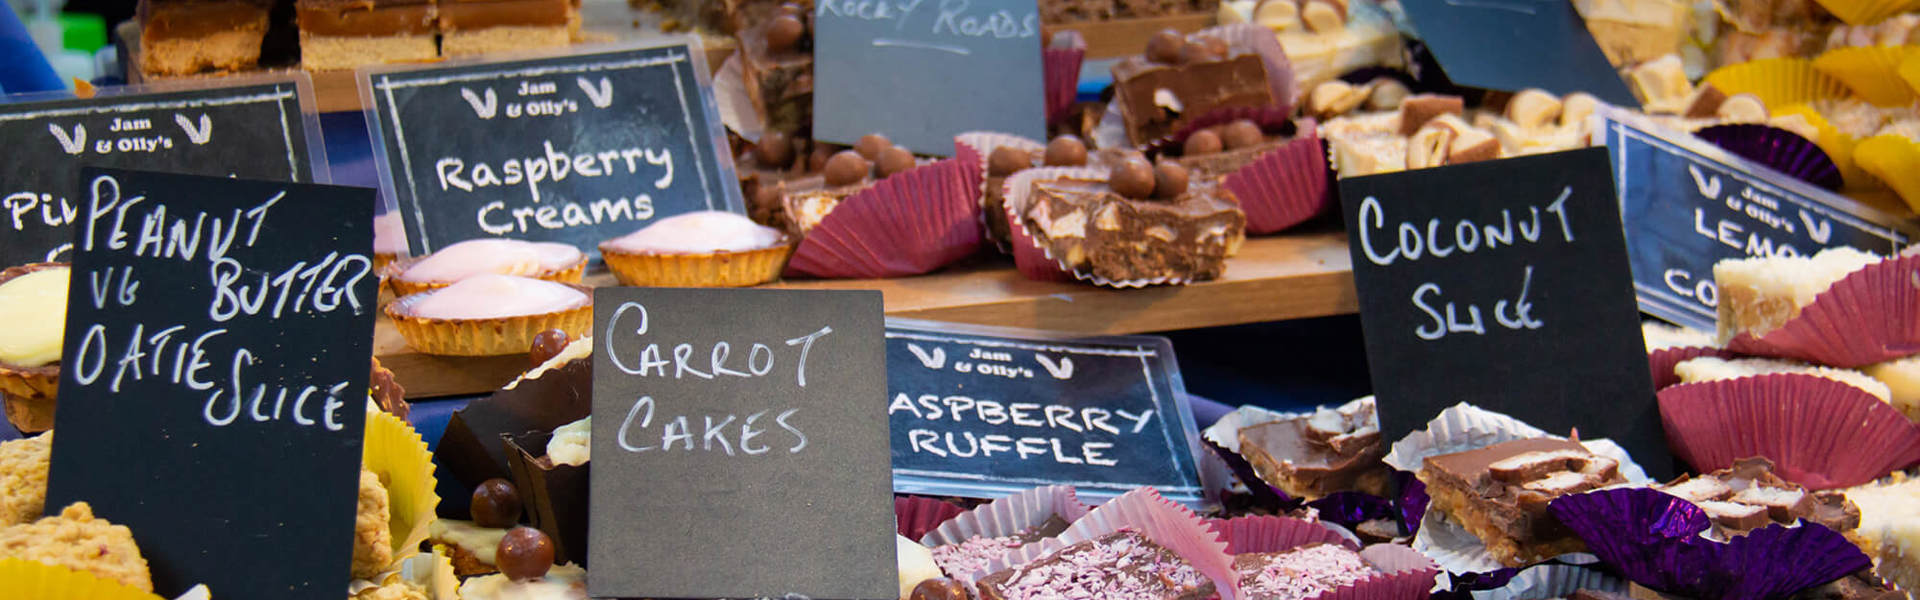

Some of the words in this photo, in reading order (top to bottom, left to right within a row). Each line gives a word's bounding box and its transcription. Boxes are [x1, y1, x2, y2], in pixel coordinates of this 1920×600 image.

[506, 102, 523, 118] &
[526, 99, 578, 118] Olly's
[518, 81, 557, 97] Jam
[96, 139, 112, 154] &
[117, 135, 173, 153] Olly's
[110, 117, 152, 132] Jam
[436, 140, 674, 203] Raspberry
[85, 175, 287, 262] PEANUT
[477, 194, 655, 236] Creams
[1726, 196, 1742, 212] &
[1745, 204, 1795, 234] Olly's
[1741, 187, 1779, 211] Jam
[1358, 186, 1575, 266] COCONUT
[209, 251, 373, 322] BUTTER
[1411, 265, 1544, 341] SLICE
[74, 323, 228, 393] OATIE
[605, 301, 833, 387] CARROT
[968, 348, 1013, 362] Jam
[203, 348, 350, 431] SLICE
[954, 361, 973, 373] &
[976, 363, 1035, 379] Olly's
[617, 396, 809, 456] CAKES
[908, 428, 1119, 467] RUFFLE
